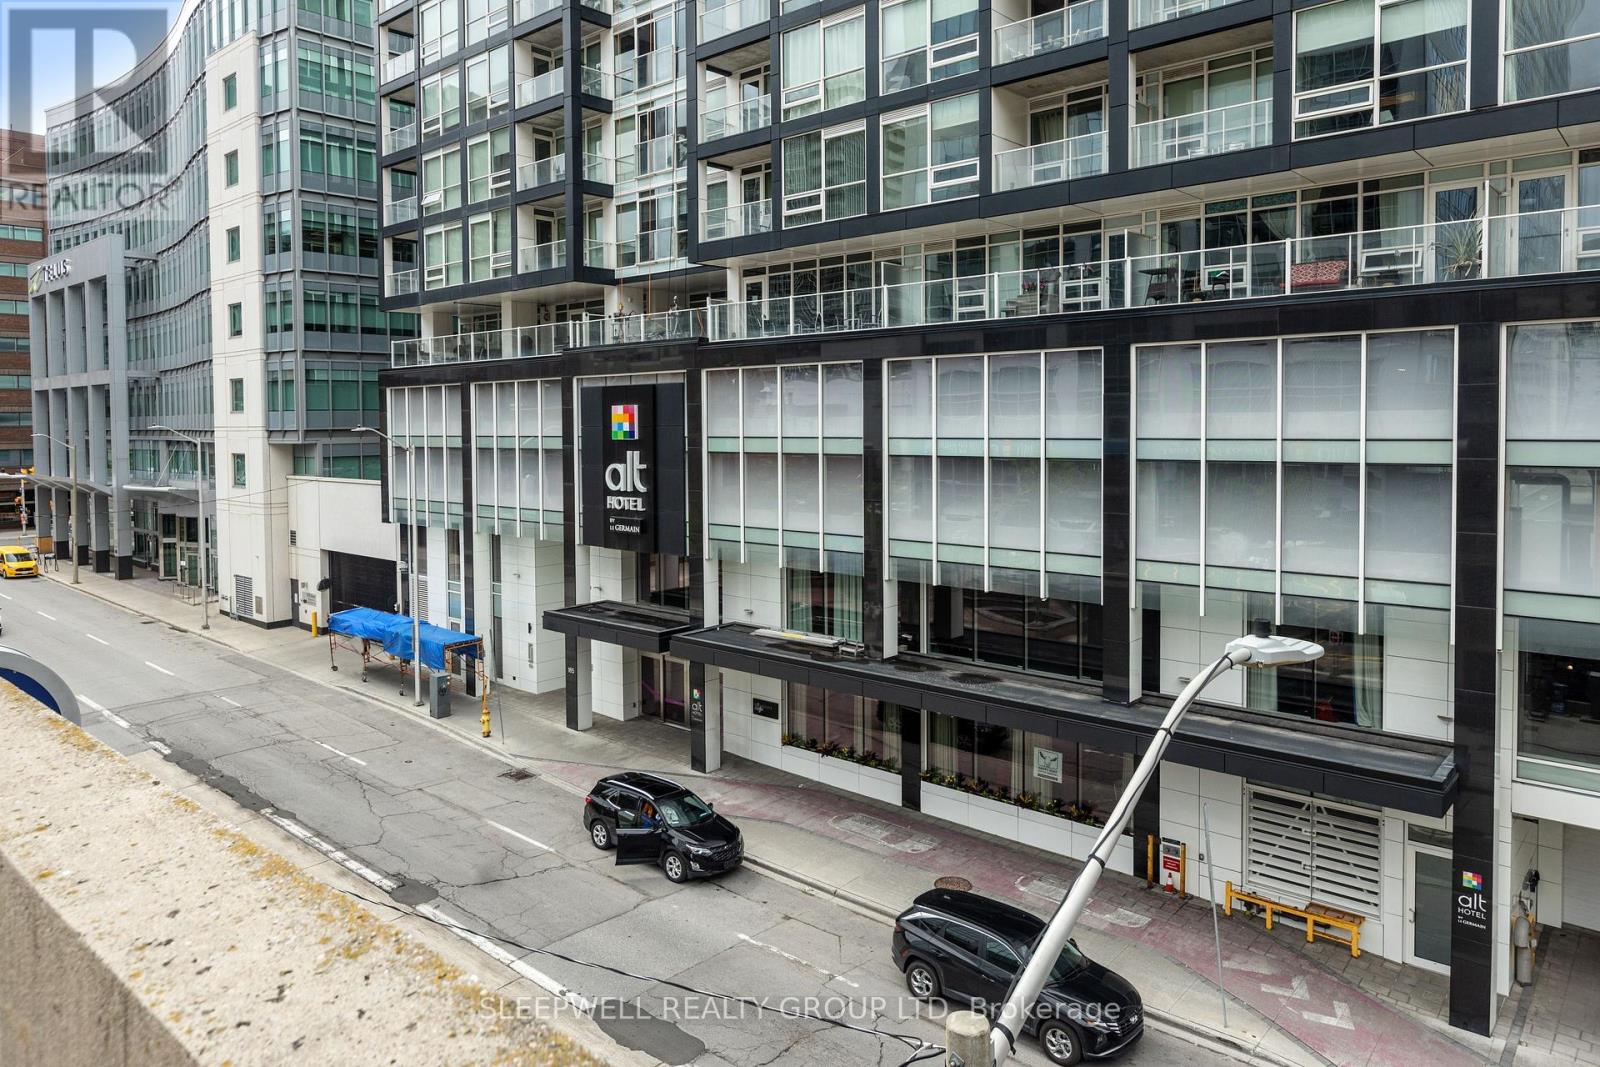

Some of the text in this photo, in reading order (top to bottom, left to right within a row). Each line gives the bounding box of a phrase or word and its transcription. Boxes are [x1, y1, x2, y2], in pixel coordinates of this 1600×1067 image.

[43, 258, 71, 283] TELUS
[605, 450, 647, 493] alt
[606, 495, 646, 511] HOTEL
[614, 524, 640, 533] GERMAIN
[1458, 892, 1487, 912] alt
[1457, 907, 1486, 920] HOTEL
[1462, 920, 1487, 929] GERMAIN
